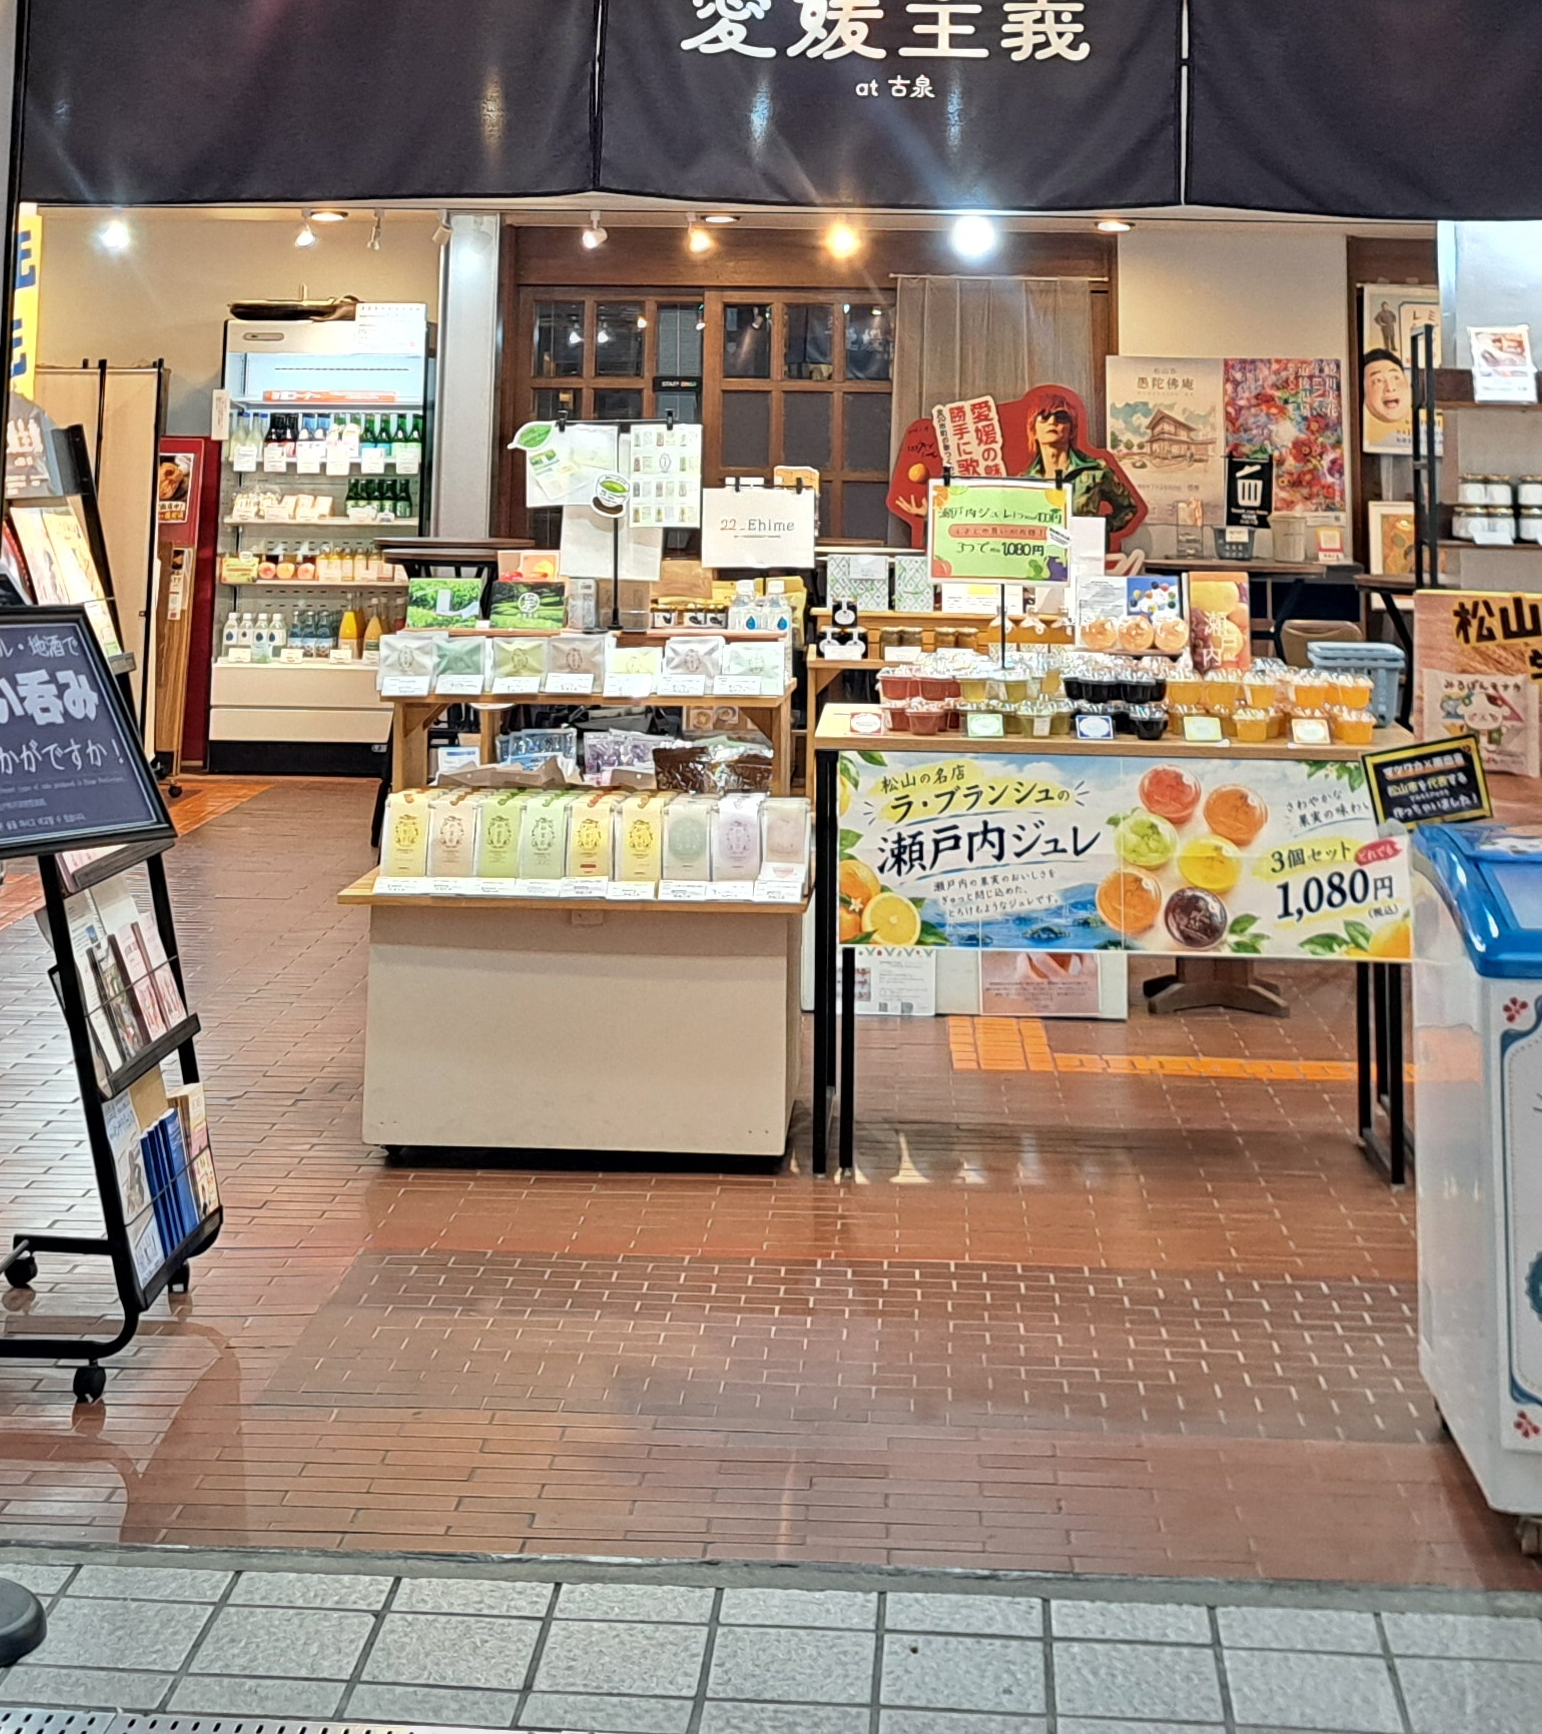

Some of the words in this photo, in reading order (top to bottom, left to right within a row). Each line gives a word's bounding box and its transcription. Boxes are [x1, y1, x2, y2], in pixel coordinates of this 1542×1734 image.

[854, 78, 879, 98] at
[887, 74, 936, 99] 古泉
[880, 764, 966, 794] 松山の名店
[890, 780, 1071, 824] ラ・ブランシュの
[1285, 788, 1344, 811] さわやかな
[876, 818, 1102, 878] 瀬戸内ジュレ
[1269, 839, 1352, 874] 3個セット
[1275, 867, 1396, 923] 1,080円
